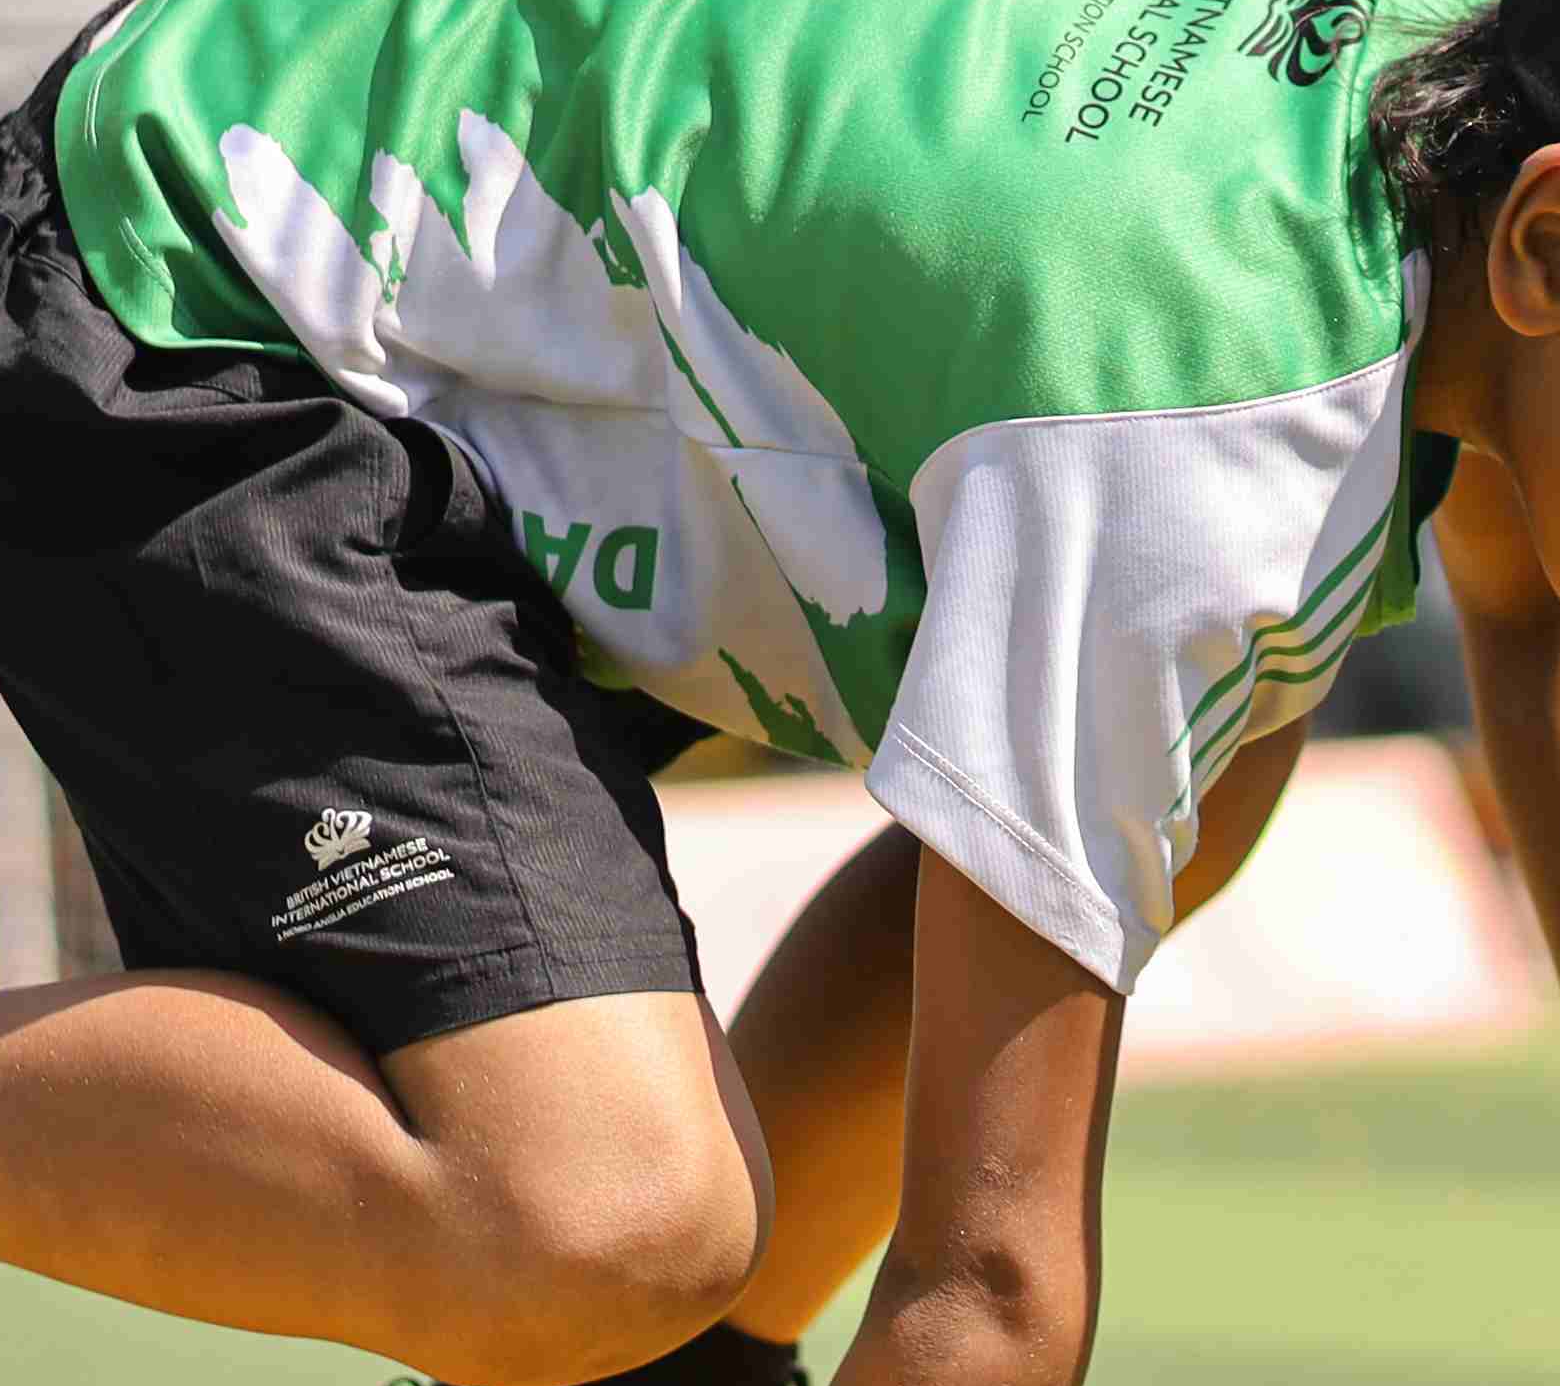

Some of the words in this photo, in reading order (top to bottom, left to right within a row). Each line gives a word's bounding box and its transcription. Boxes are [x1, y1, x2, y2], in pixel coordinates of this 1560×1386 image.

[1021, 31, 1084, 123] SCHOOL
[1065, 25, 1158, 143] SCHOOL
[272, 872, 379, 927] INTERNATIONAL
[380, 848, 451, 882] SCHOOL
[286, 877, 329, 910] BRITISH
[330, 837, 429, 886] VIETNAMESE
[346, 881, 405, 915] EDUCATION
[405, 868, 455, 891] SCHOOL
